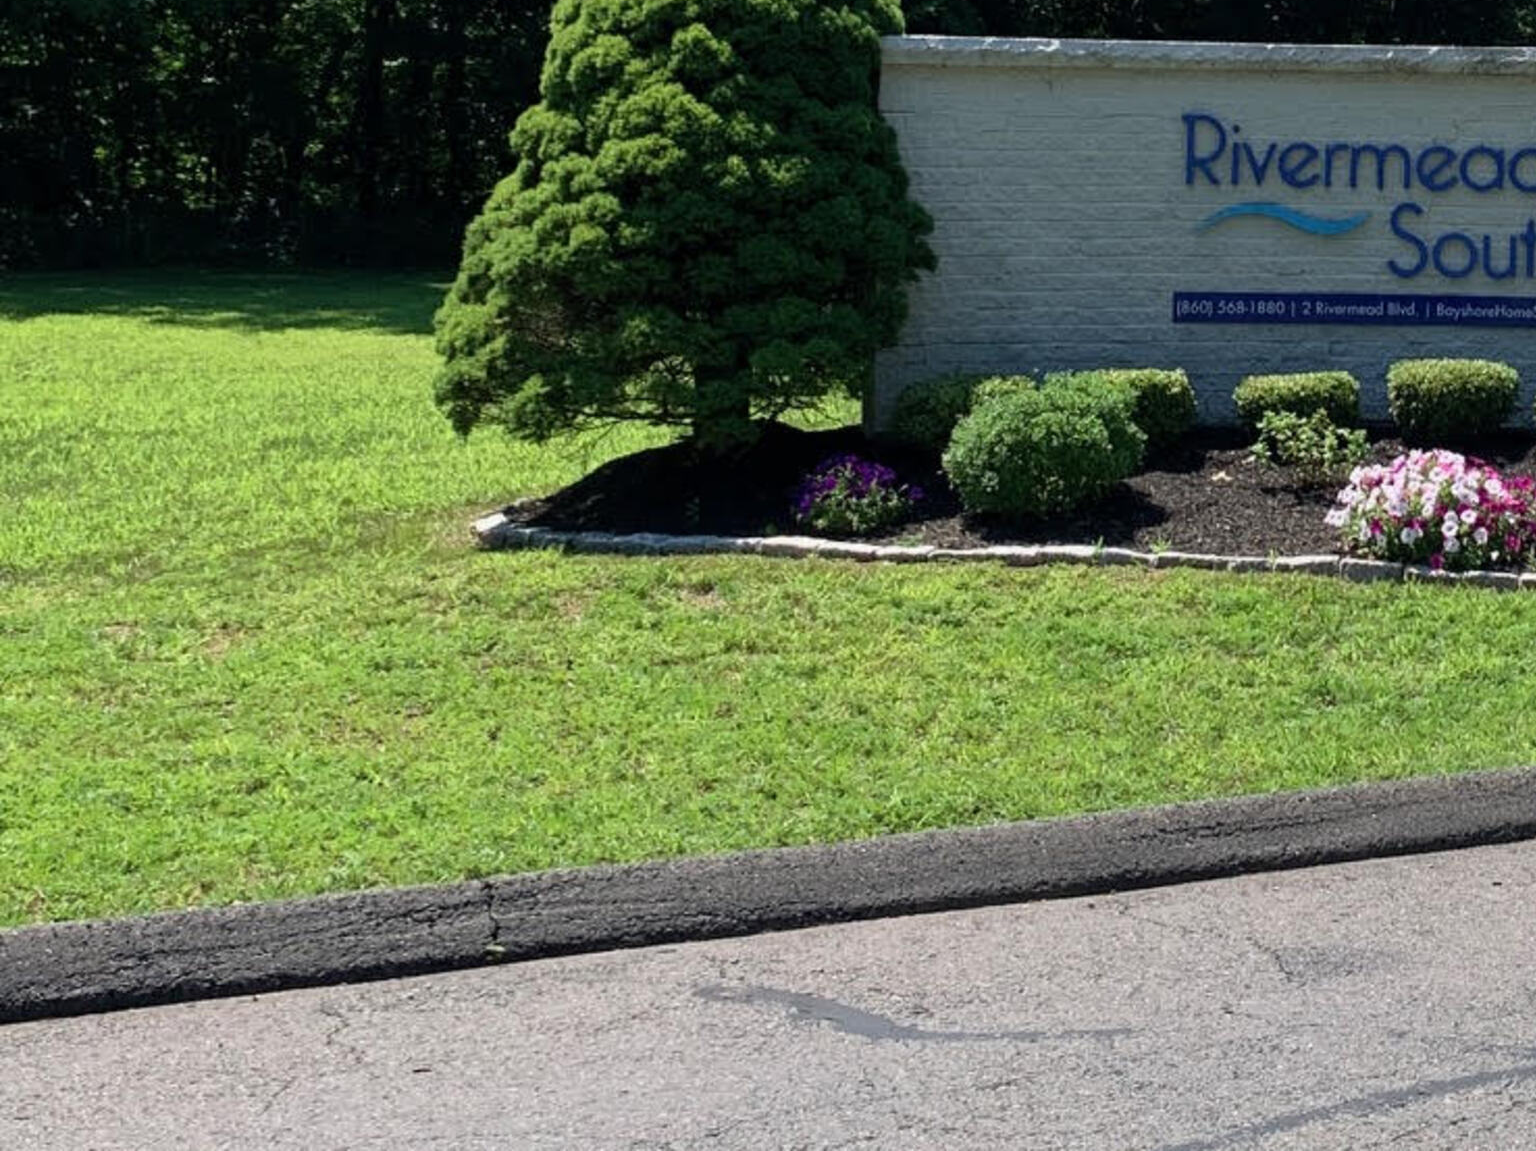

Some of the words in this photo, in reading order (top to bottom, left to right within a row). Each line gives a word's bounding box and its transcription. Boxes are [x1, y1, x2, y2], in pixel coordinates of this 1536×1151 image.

[1177, 299, 1213, 317] (860)
[1216, 299, 1286, 315] 568-1880
[1301, 300, 1311, 315] 2
[1315, 300, 1384, 316] Rivermead
